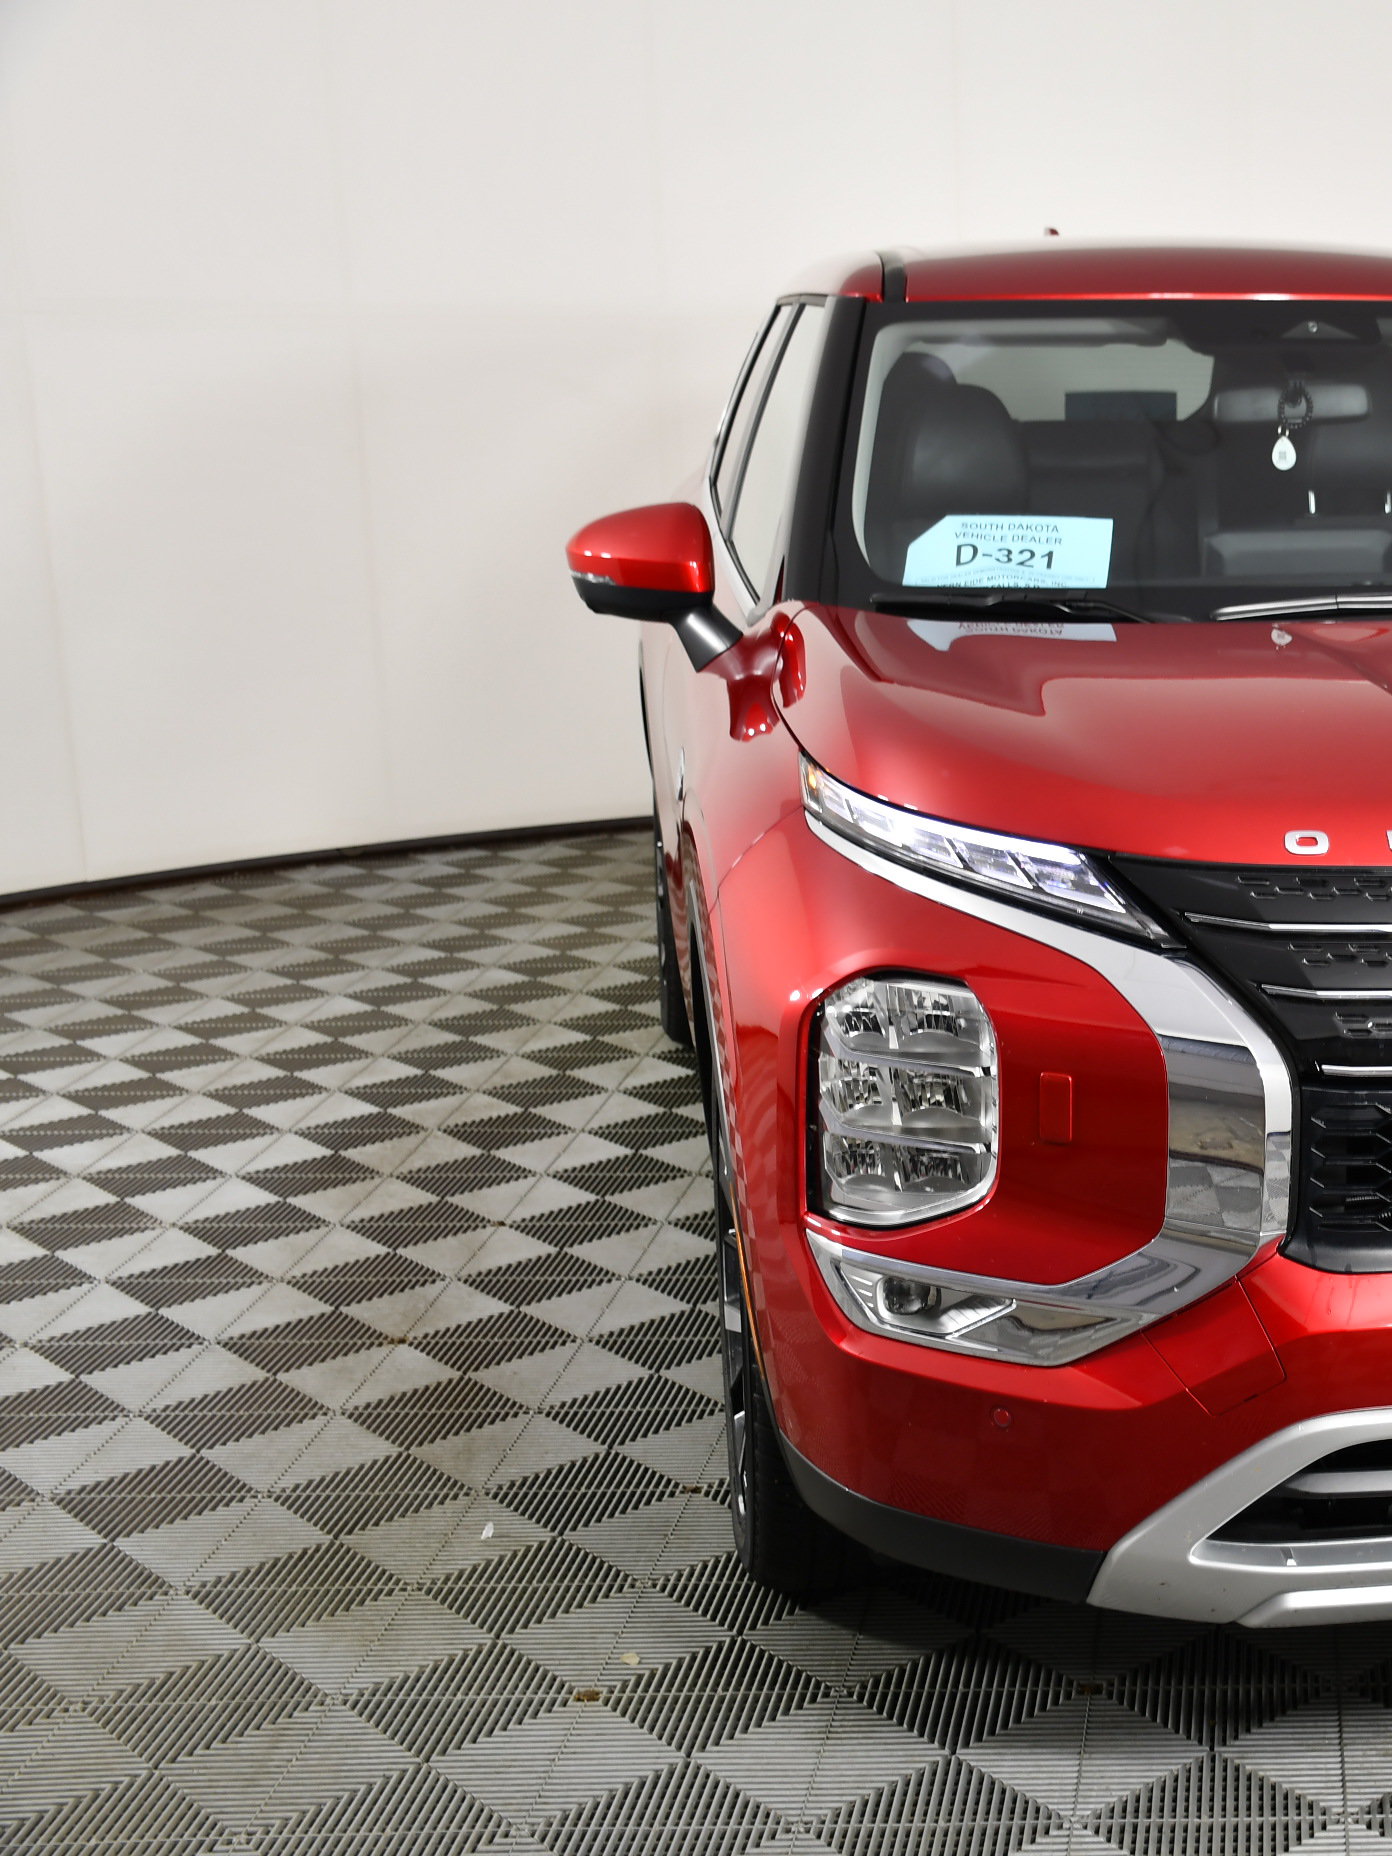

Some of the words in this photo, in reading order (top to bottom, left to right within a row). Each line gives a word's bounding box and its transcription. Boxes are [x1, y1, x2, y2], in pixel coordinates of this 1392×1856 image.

[961, 522, 1004, 532] SOUTH
[1008, 522, 1059, 533] DAKOTA
[954, 531, 1008, 543] VEHICLE
[1012, 534, 1063, 545] DEALER
[955, 543, 1055, 570] D-321
